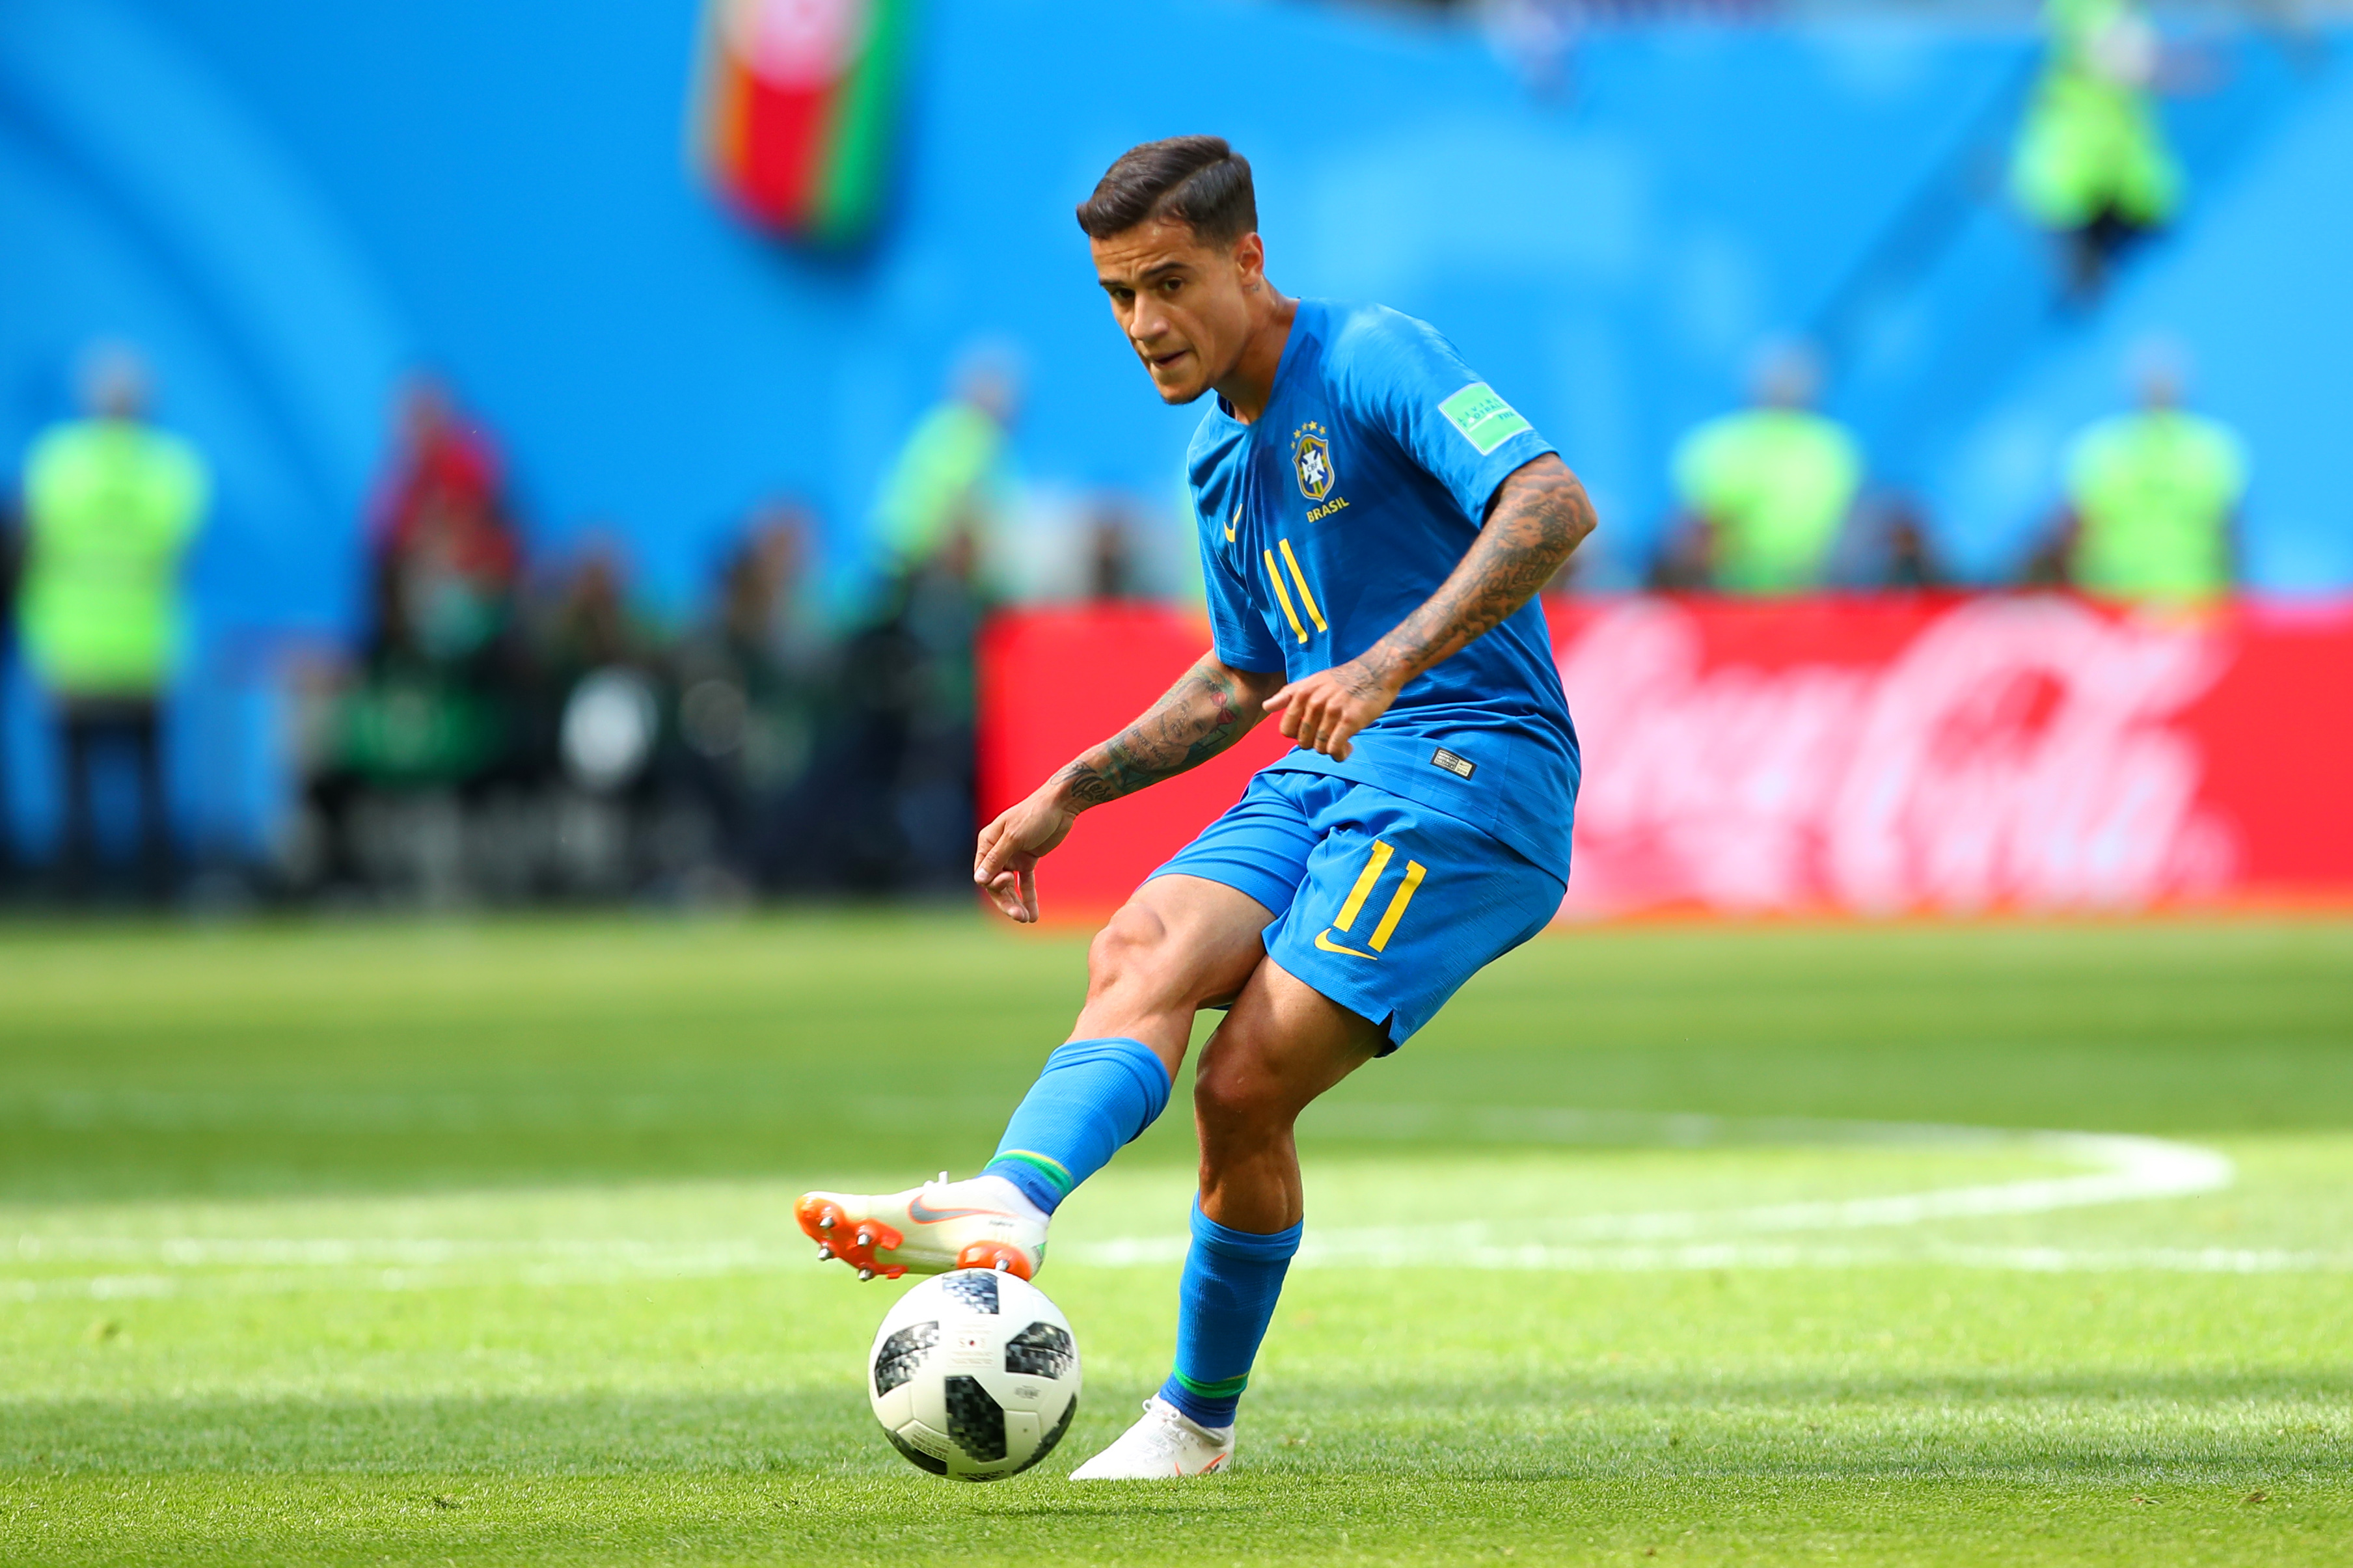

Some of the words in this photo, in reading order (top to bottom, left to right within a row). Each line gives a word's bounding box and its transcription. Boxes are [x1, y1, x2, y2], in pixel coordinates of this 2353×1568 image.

[1306, 496, 1350, 523] BRASIL
[1264, 538, 1328, 644] 11
[1333, 839, 1428, 953] 11
